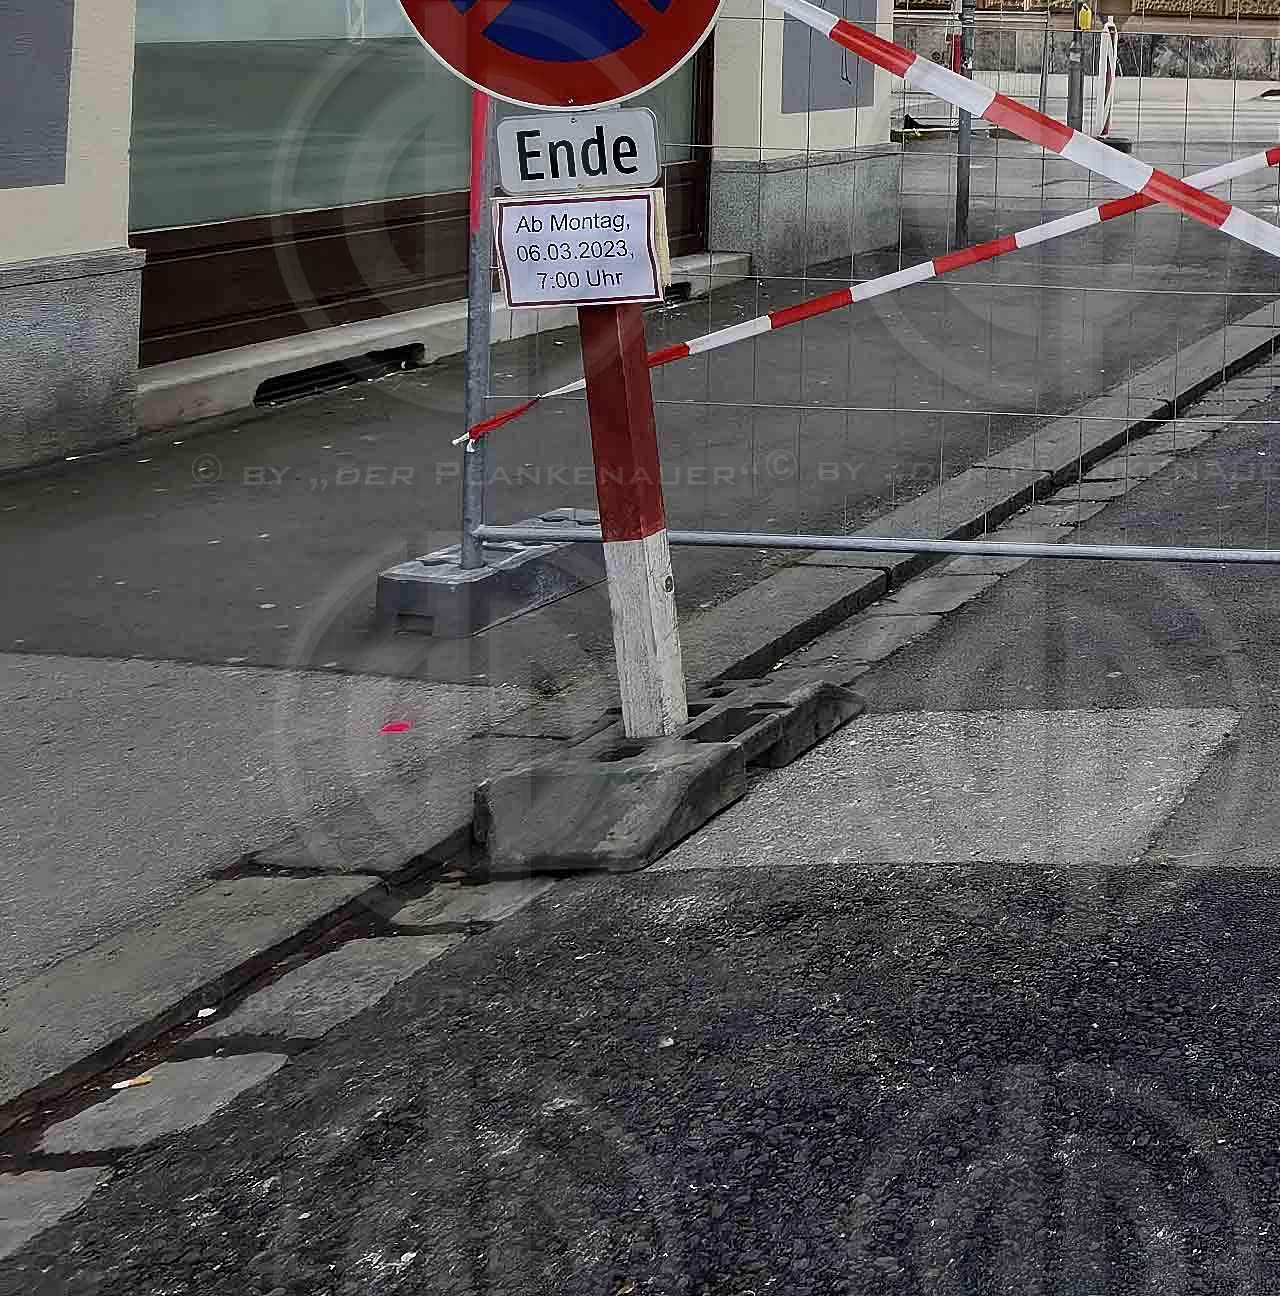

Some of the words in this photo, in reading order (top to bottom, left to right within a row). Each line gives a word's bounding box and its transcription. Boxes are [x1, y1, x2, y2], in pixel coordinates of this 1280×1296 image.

[517, 126, 638, 181] Ende
[516, 215, 543, 233] Ab
[550, 213, 632, 233] Montag,
[516, 240, 635, 263] 06.03.2023,
[537, 270, 581, 291] 7:00
[586, 268, 623, 290] Uhr
